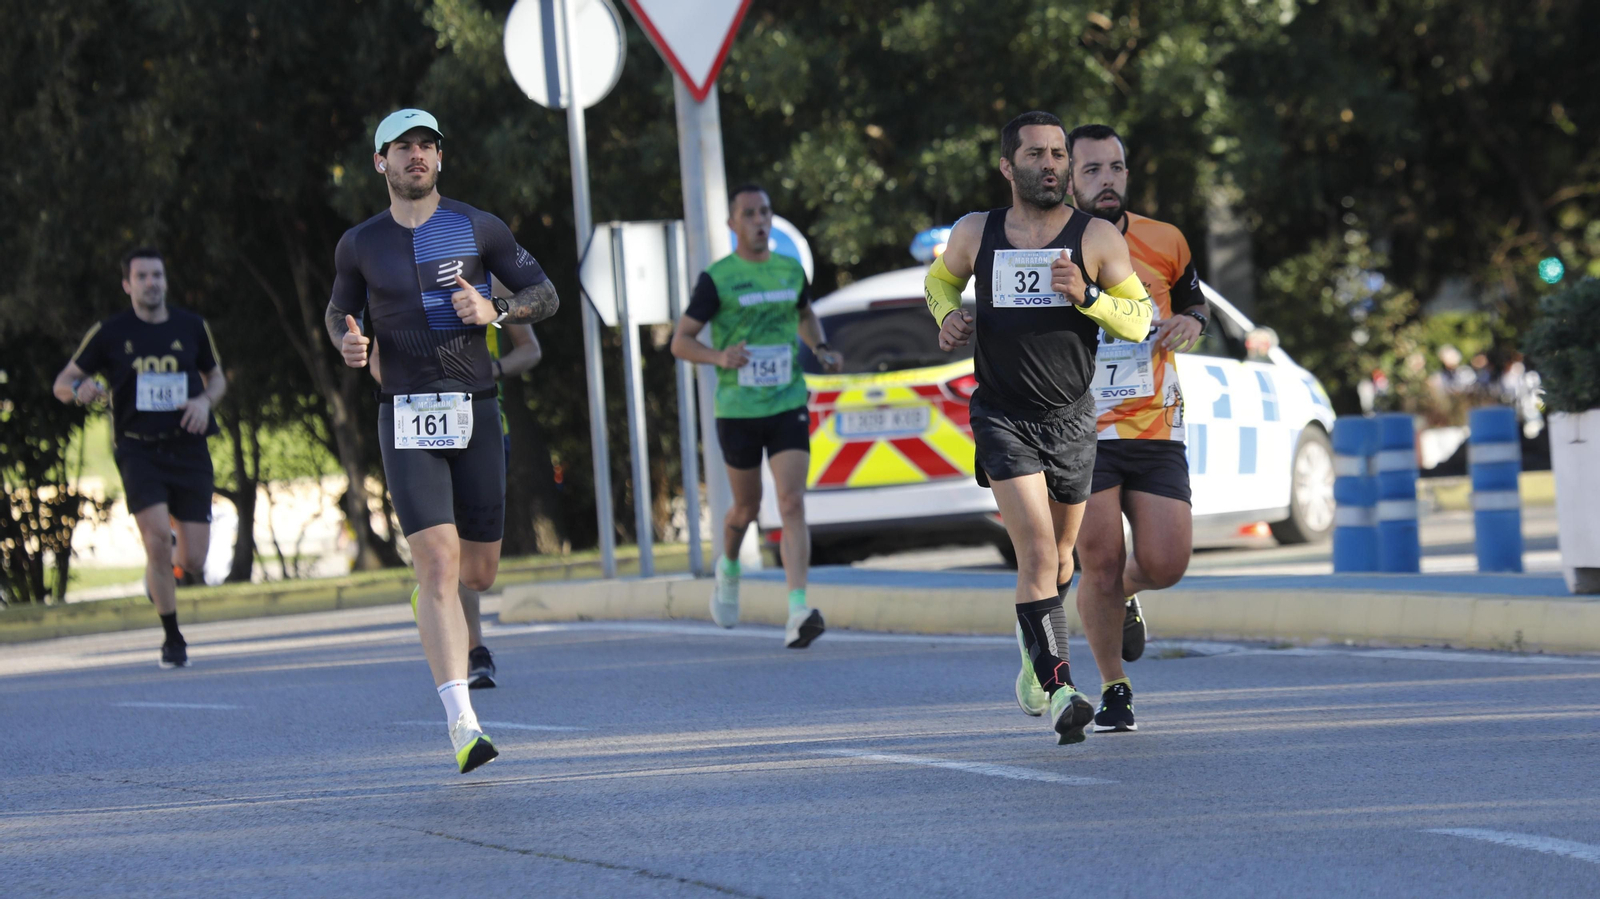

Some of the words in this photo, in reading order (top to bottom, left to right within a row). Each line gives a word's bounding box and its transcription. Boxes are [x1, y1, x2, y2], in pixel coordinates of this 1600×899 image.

[1014, 271, 1040, 293] 32
[1013, 297, 1052, 305] EVOS
[752, 361, 776, 377] 154
[1106, 364, 1118, 386] 7
[1100, 388, 1137, 398] EVOS
[411, 413, 448, 436] 161
[416, 439, 455, 447] EVOS
